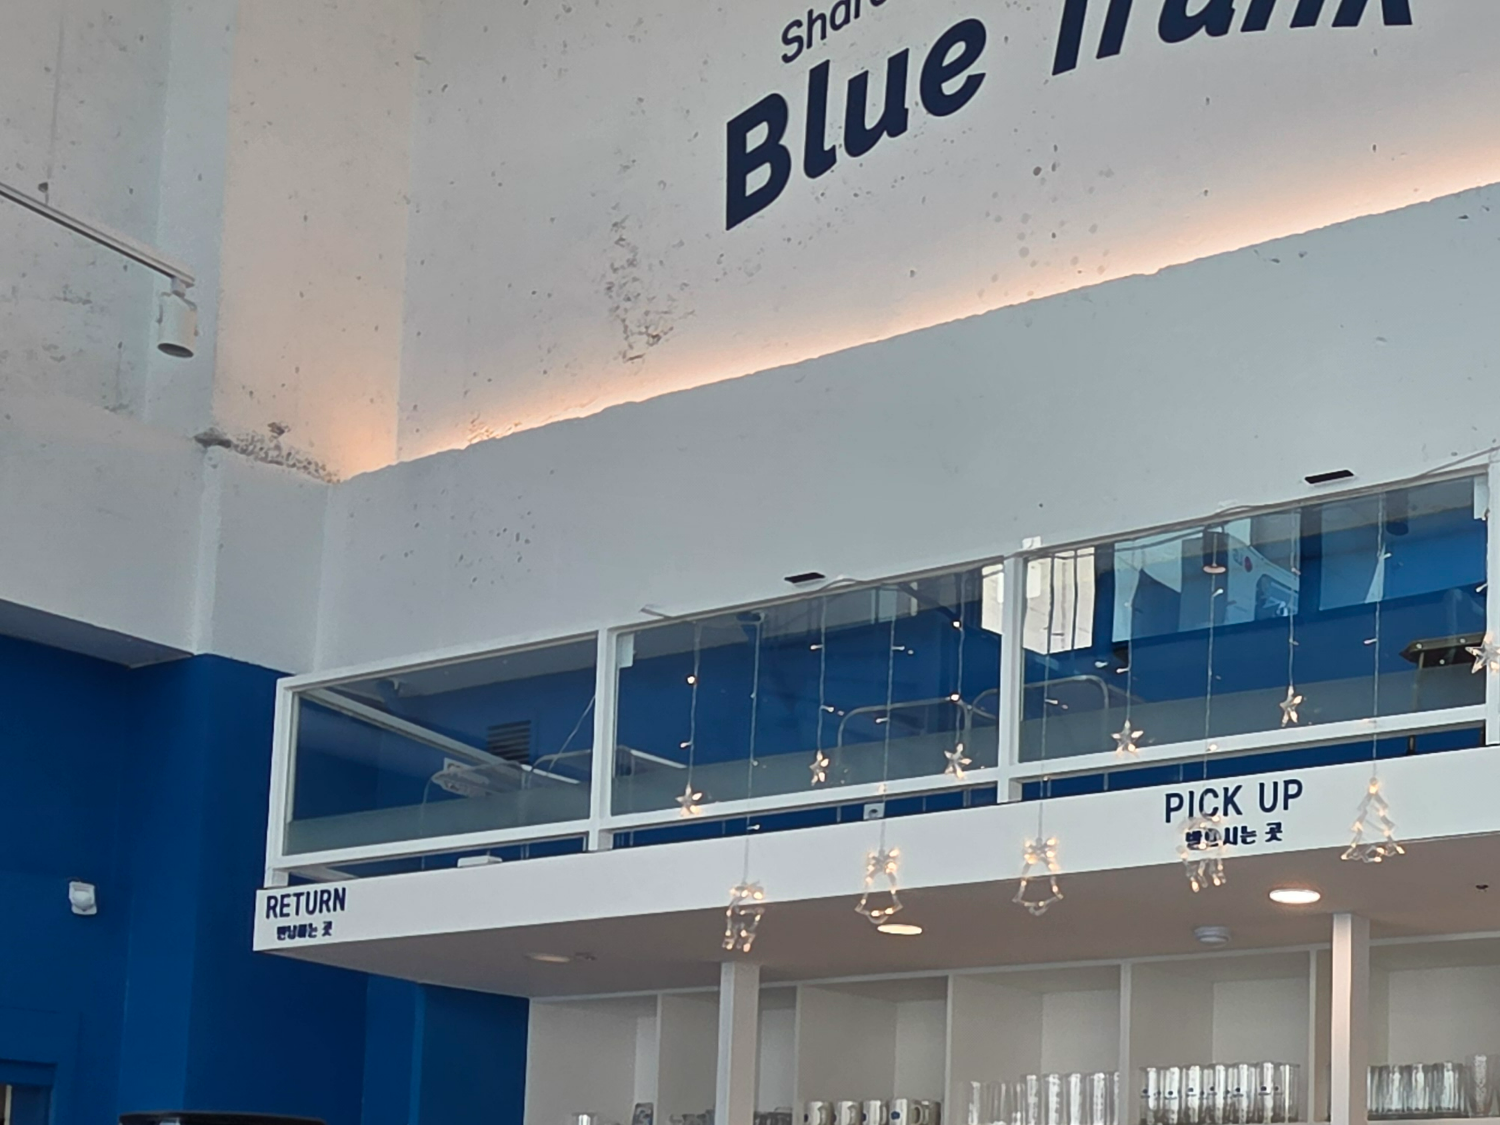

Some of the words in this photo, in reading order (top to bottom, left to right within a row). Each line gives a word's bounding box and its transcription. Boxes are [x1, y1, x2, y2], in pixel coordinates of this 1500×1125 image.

[726, 18, 987, 231] Blue
[1165, 784, 1243, 823] PICK
[1258, 779, 1303, 812] UP
[1264, 821, 1283, 842] 곳
[265, 887, 346, 919] RETURN
